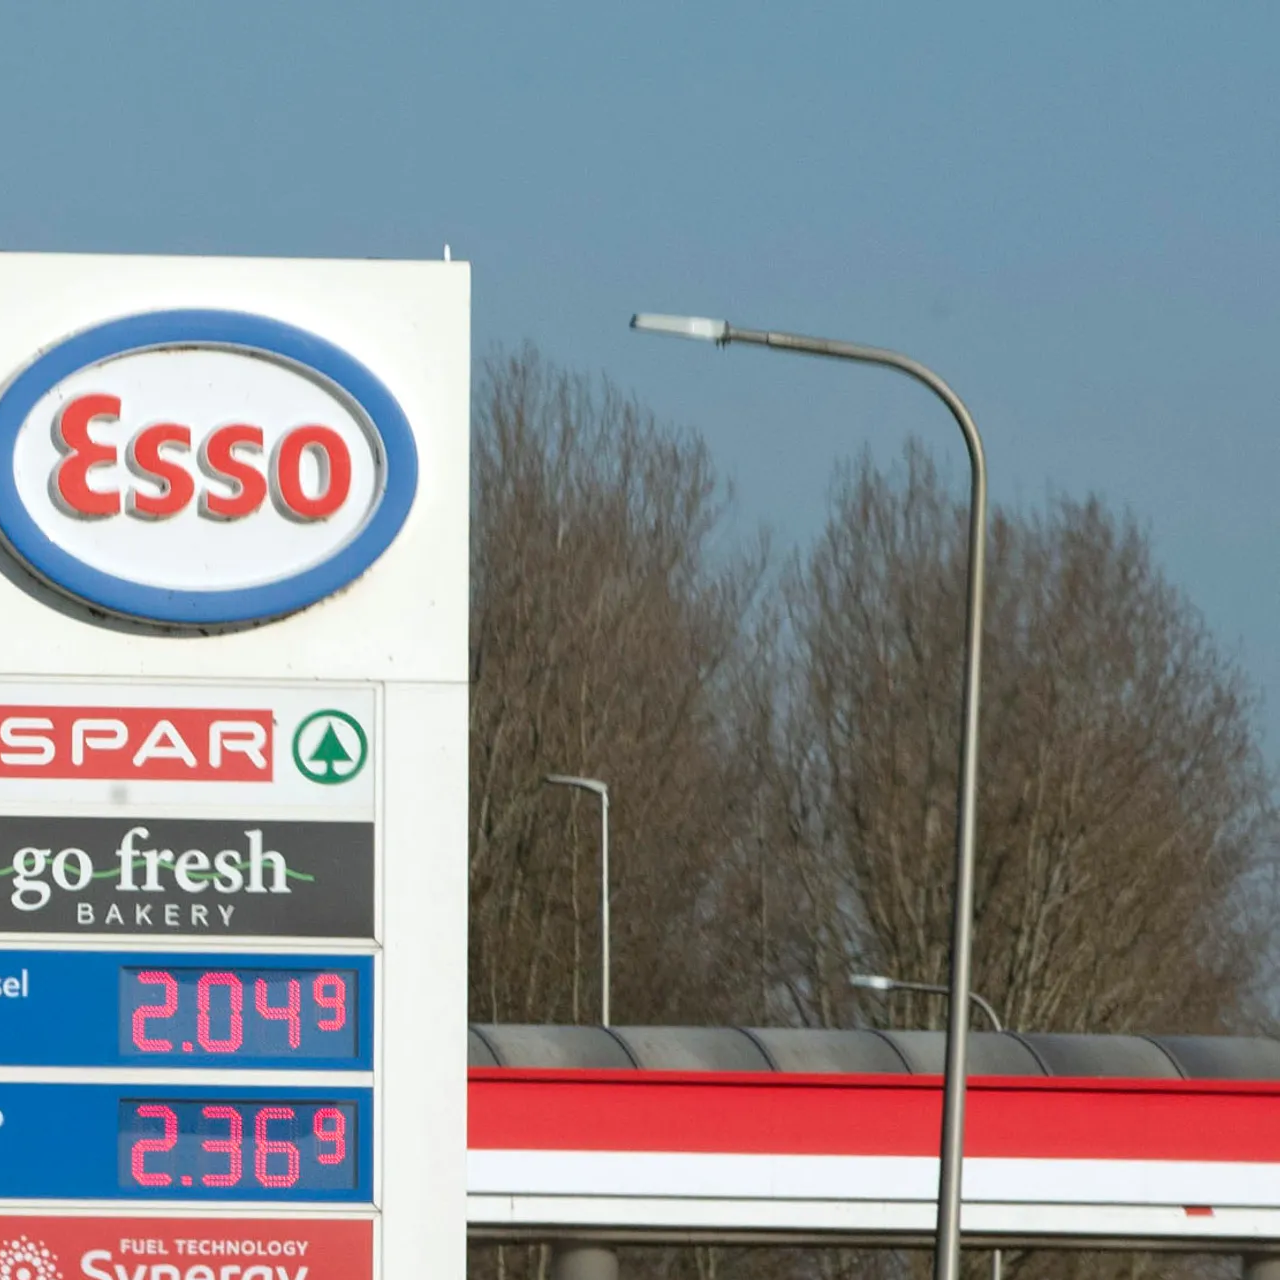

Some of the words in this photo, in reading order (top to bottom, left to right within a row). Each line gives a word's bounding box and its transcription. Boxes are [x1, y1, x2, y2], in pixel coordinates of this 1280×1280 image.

[48, 393, 352, 523] Esso
[10, 846, 94, 911] go
[115, 827, 293, 894] fresh
[76, 902, 236, 926] BAKERY
[131, 970, 347, 1053] 2.049
[131, 1105, 347, 1189] 2.369
[119, 1238, 170, 1256] FUEL
[175, 1239, 309, 1257] TECHNOLOGY
